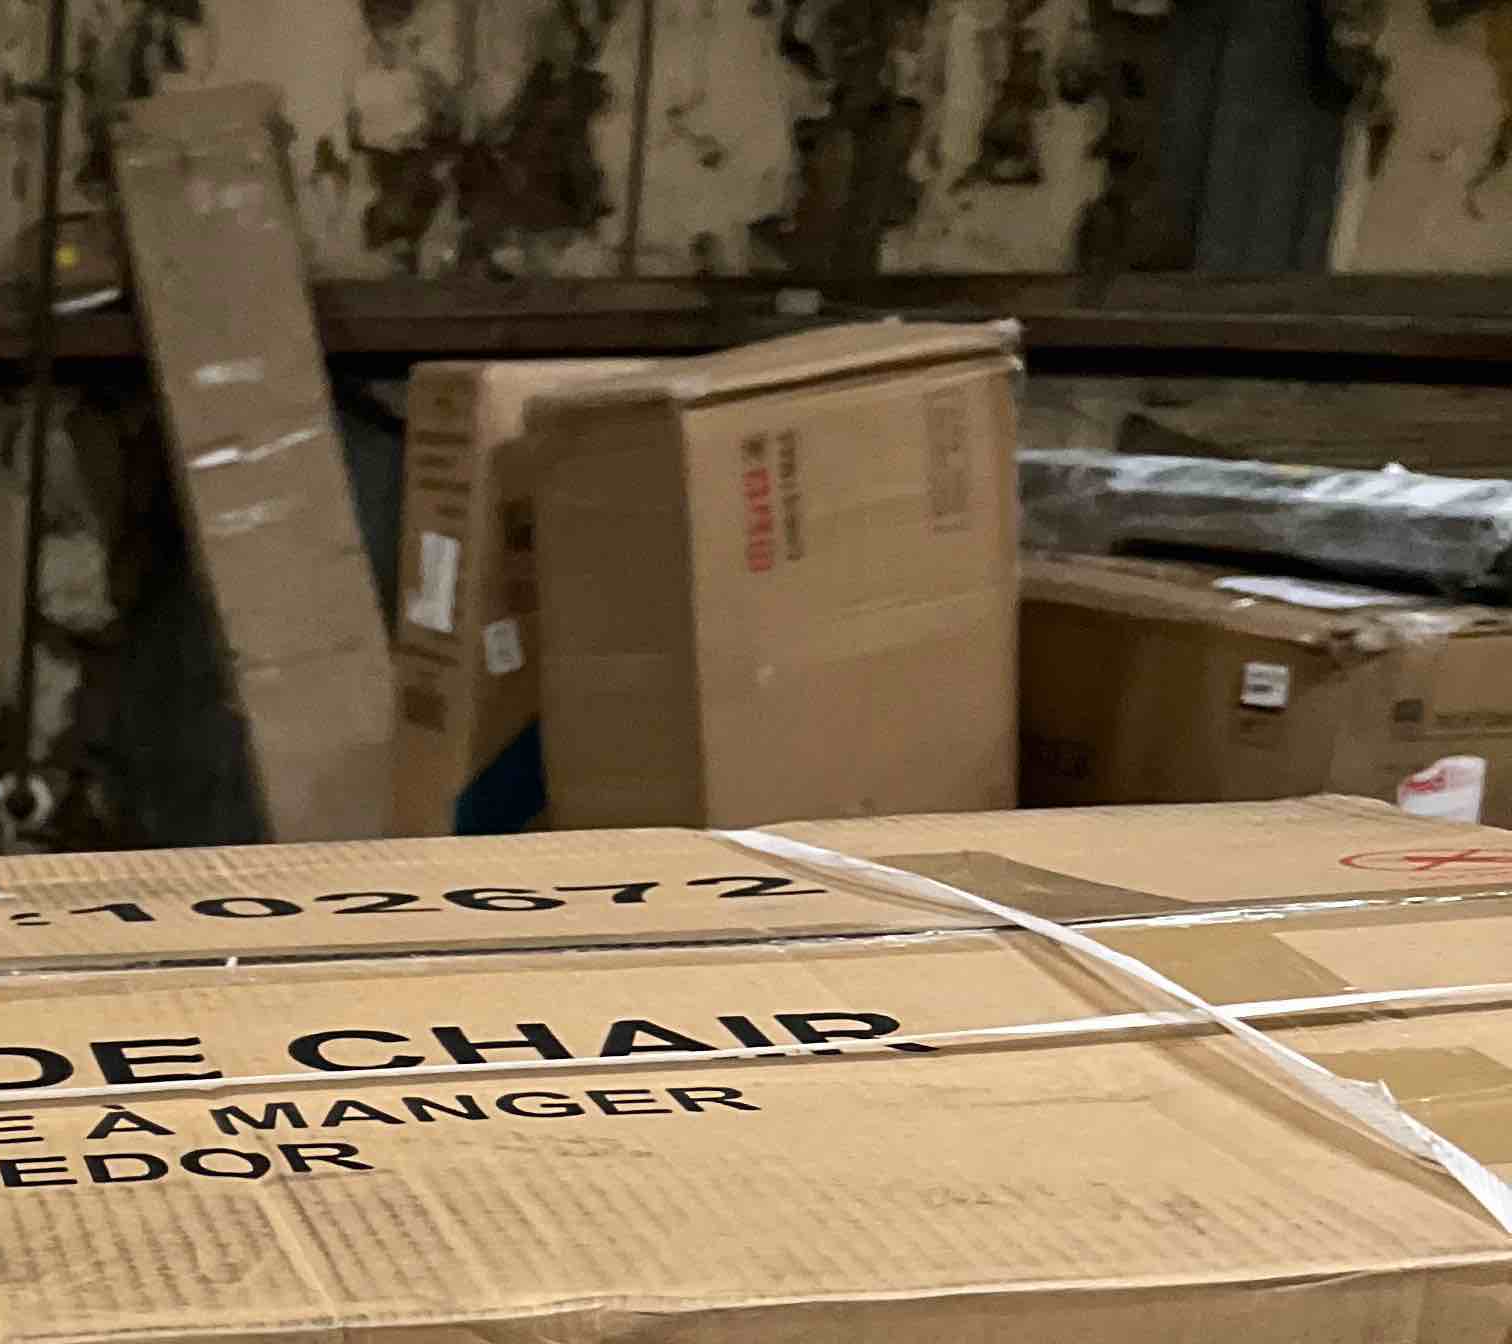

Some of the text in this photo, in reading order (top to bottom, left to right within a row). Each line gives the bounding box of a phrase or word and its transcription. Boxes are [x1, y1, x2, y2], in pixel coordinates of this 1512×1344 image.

[287, 1010, 938, 1070] CHAIR
[87, 1103, 175, 1139] À
[215, 1084, 761, 1132] MANGER
